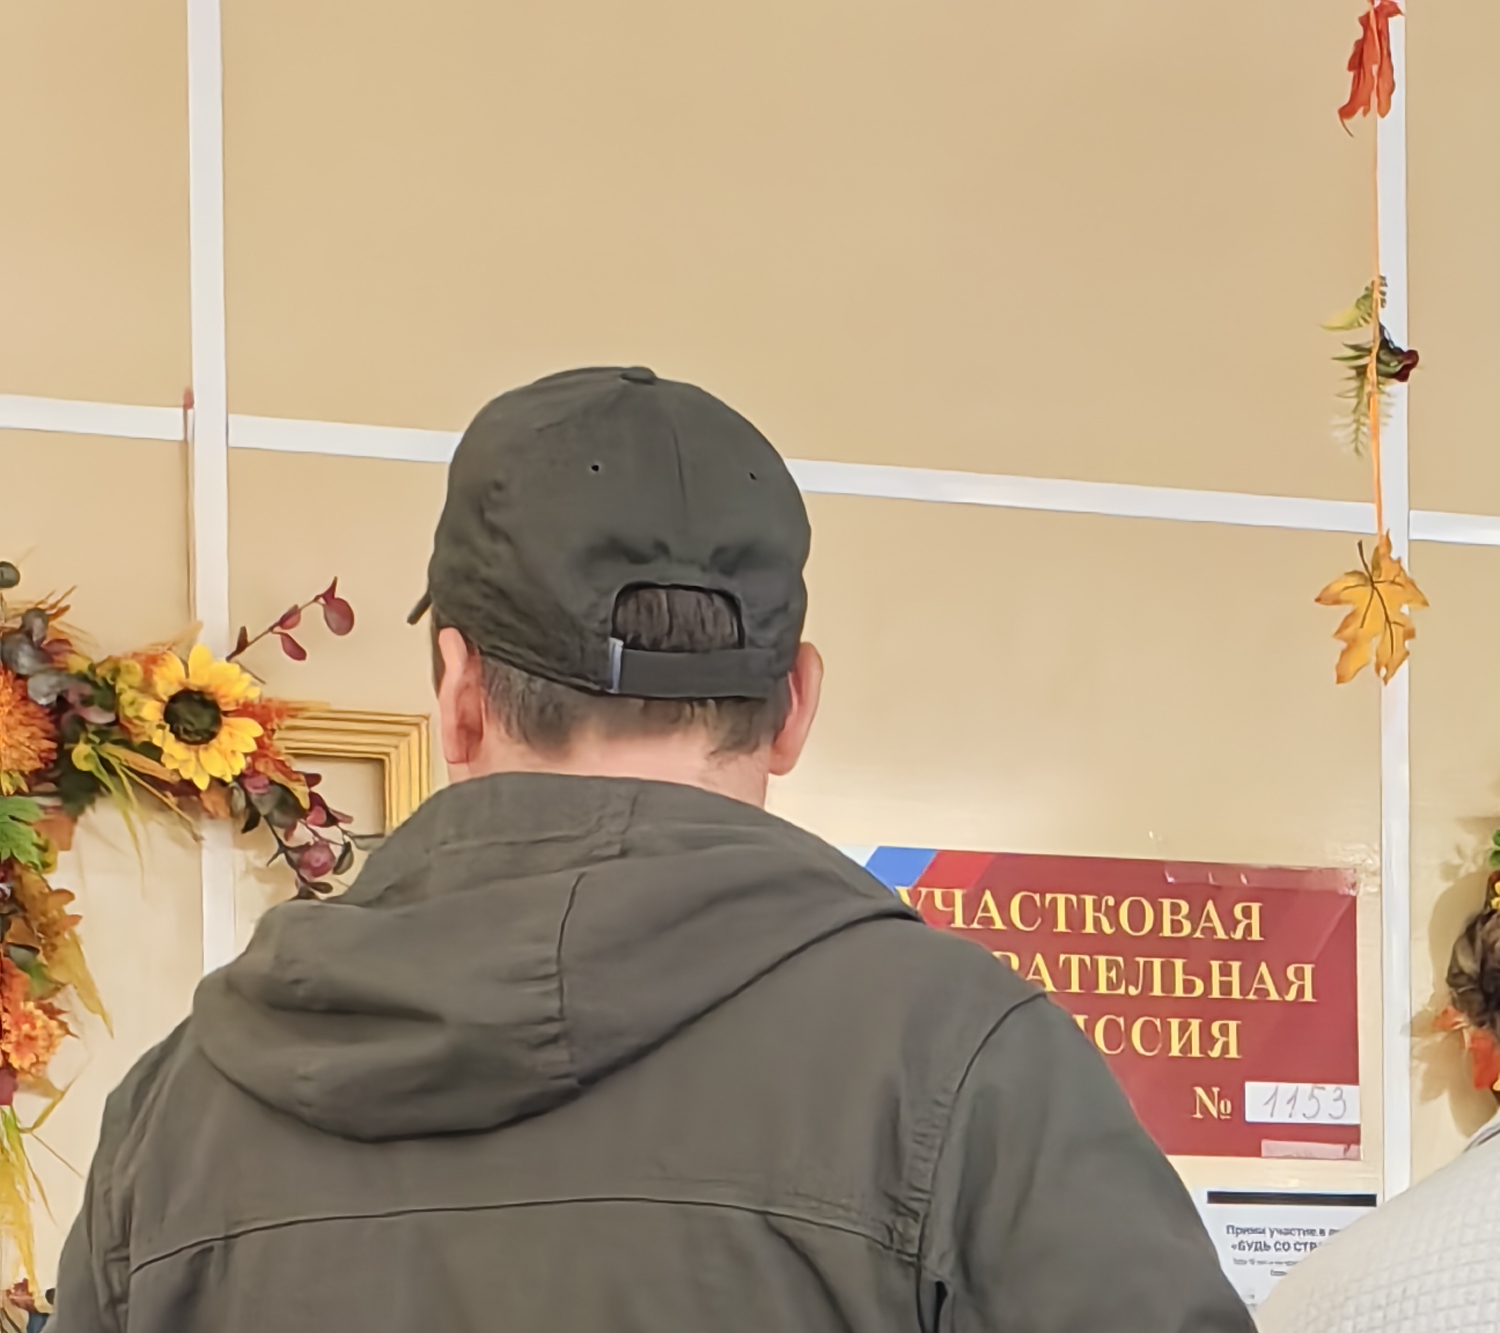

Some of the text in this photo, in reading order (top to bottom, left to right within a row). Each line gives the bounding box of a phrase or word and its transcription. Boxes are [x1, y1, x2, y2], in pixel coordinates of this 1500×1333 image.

[895, 886, 1264, 940] УЧАСТКОВАЯ
[1072, 1015, 1242, 1059] ССИЯ
[1192, 1085, 1347, 1120] № 1153
[1274, 1241, 1291, 1252] СО
[1293, 1242, 1322, 1253] СТР
